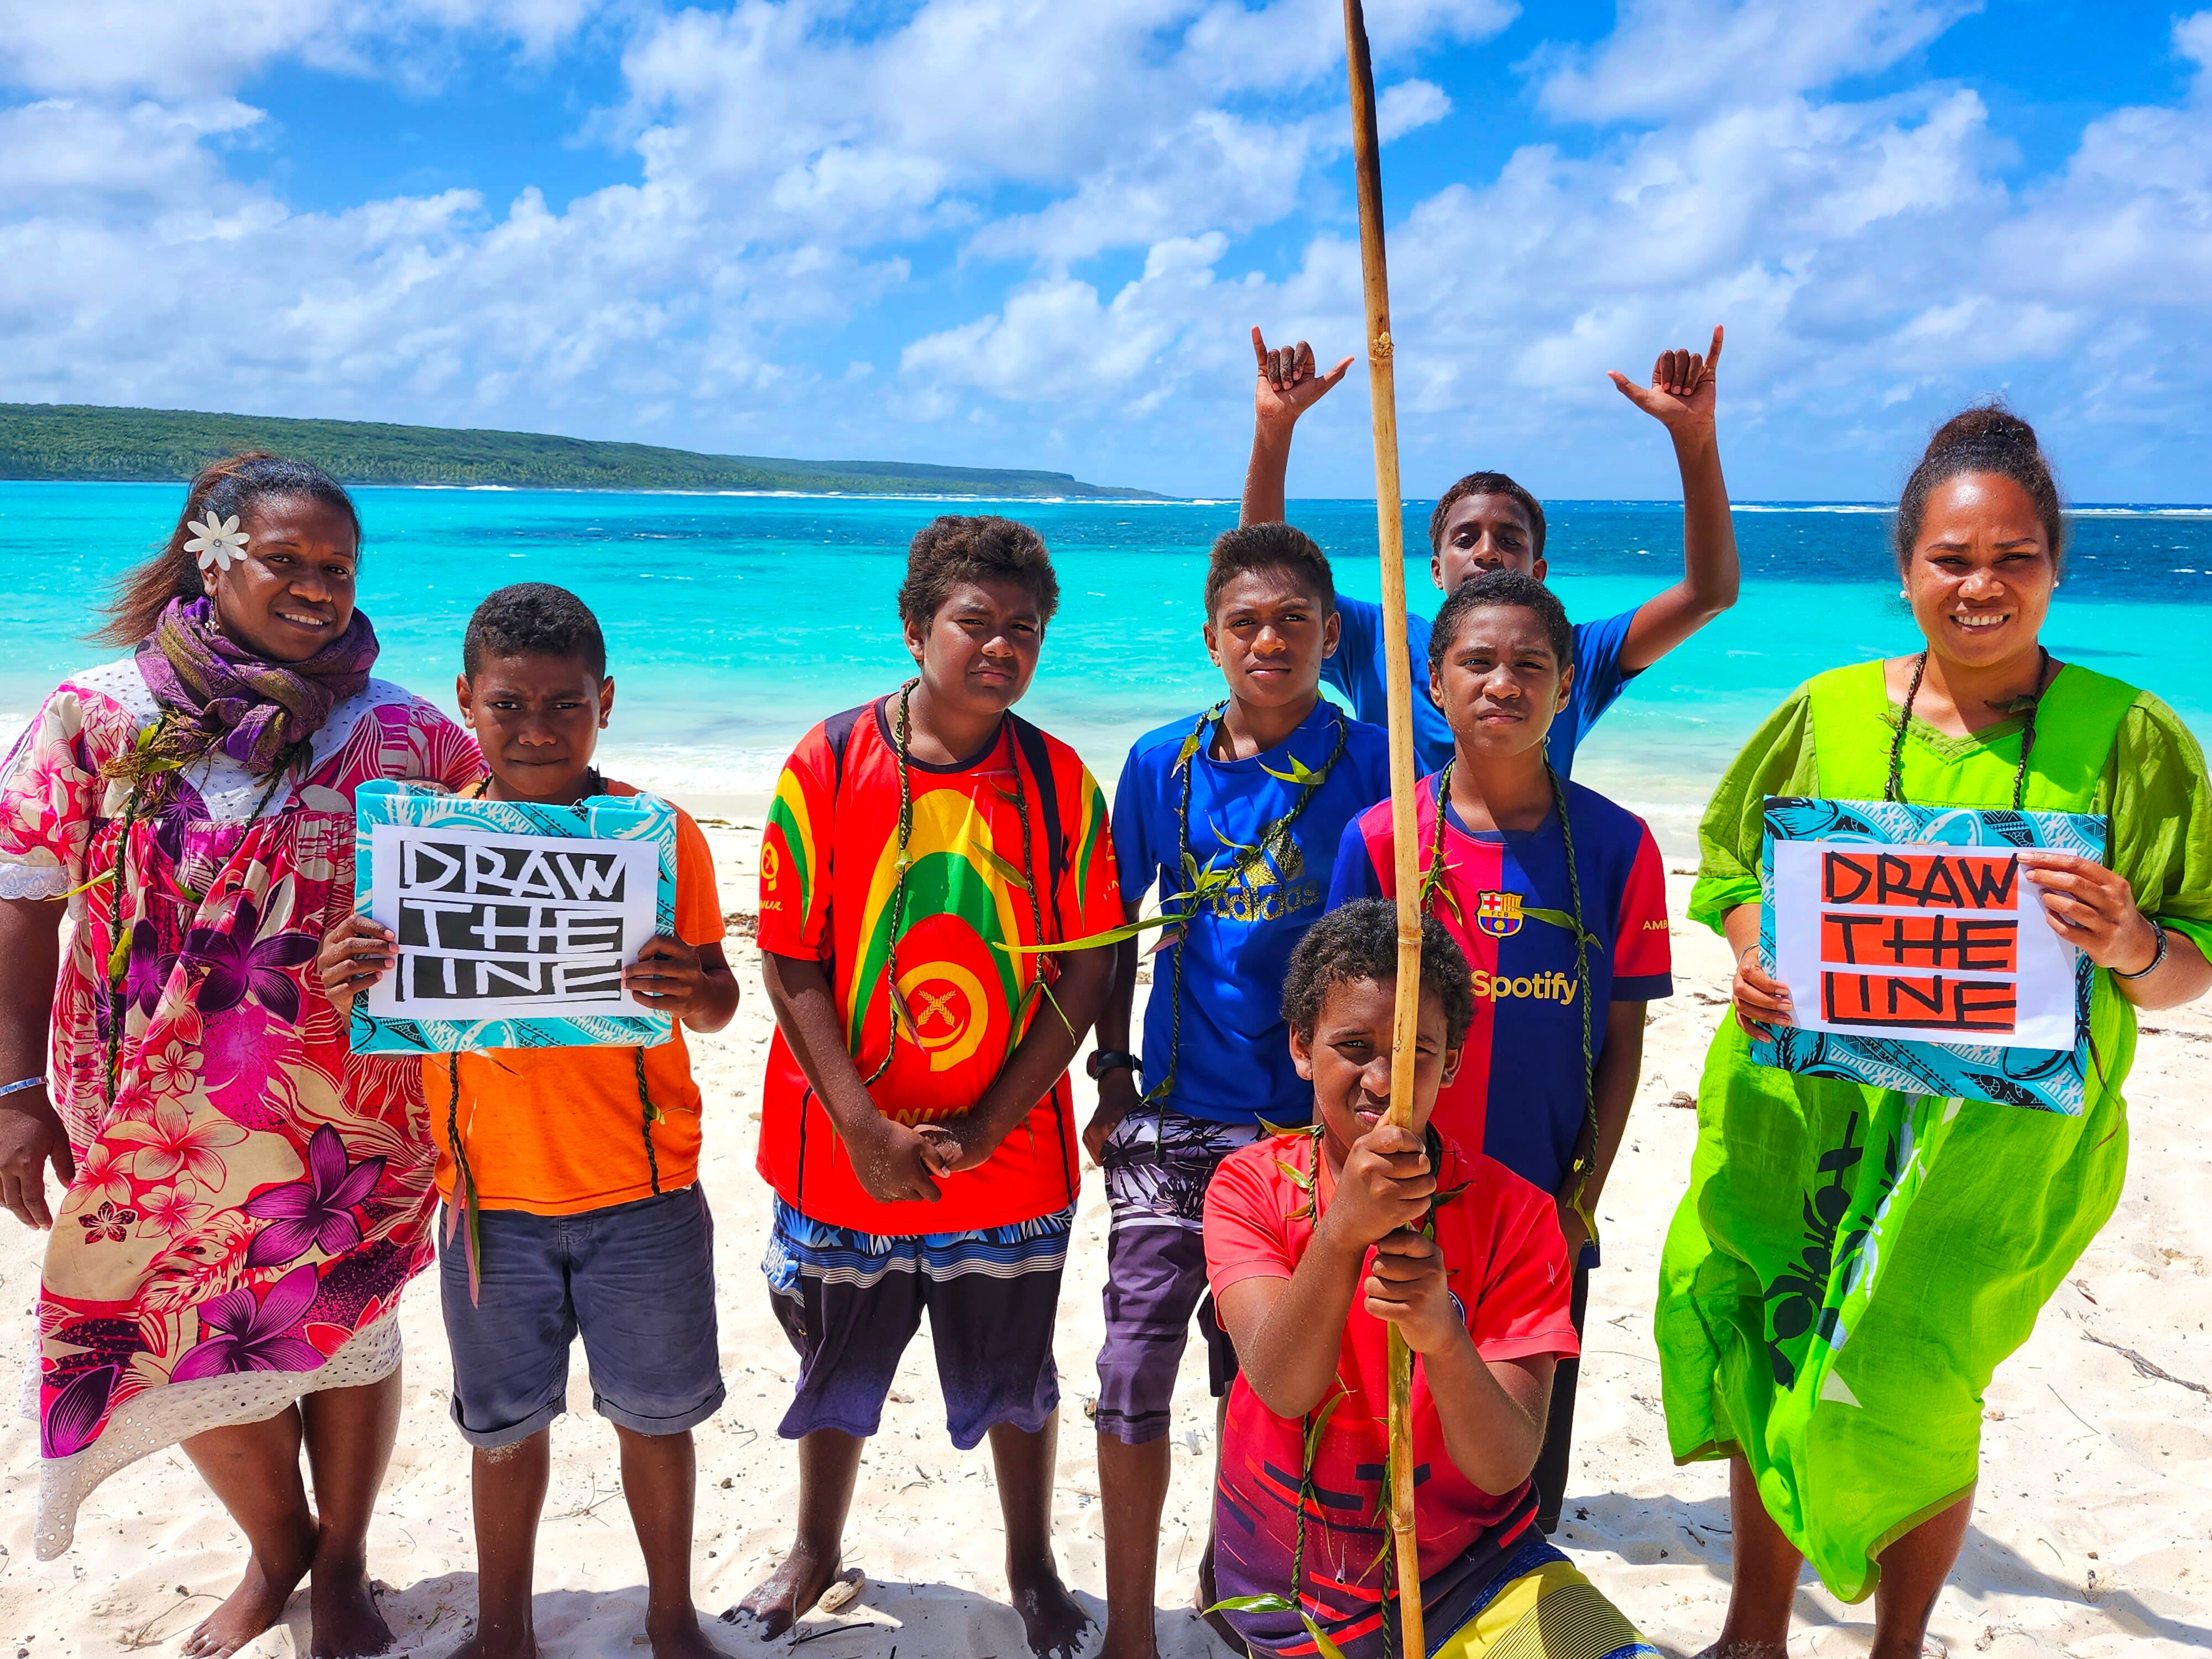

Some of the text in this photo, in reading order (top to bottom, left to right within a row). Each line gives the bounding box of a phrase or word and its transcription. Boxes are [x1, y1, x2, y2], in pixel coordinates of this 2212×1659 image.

[404, 841, 626, 900] DRAW
[1825, 851, 2018, 909] DRAW
[403, 899, 624, 954] THE
[1213, 880, 1319, 922] adidas
[1825, 915, 2018, 970] THE
[402, 954, 622, 1002] LINE
[1470, 970, 1578, 1005] Spotify
[1825, 972, 2017, 1030] LINE
